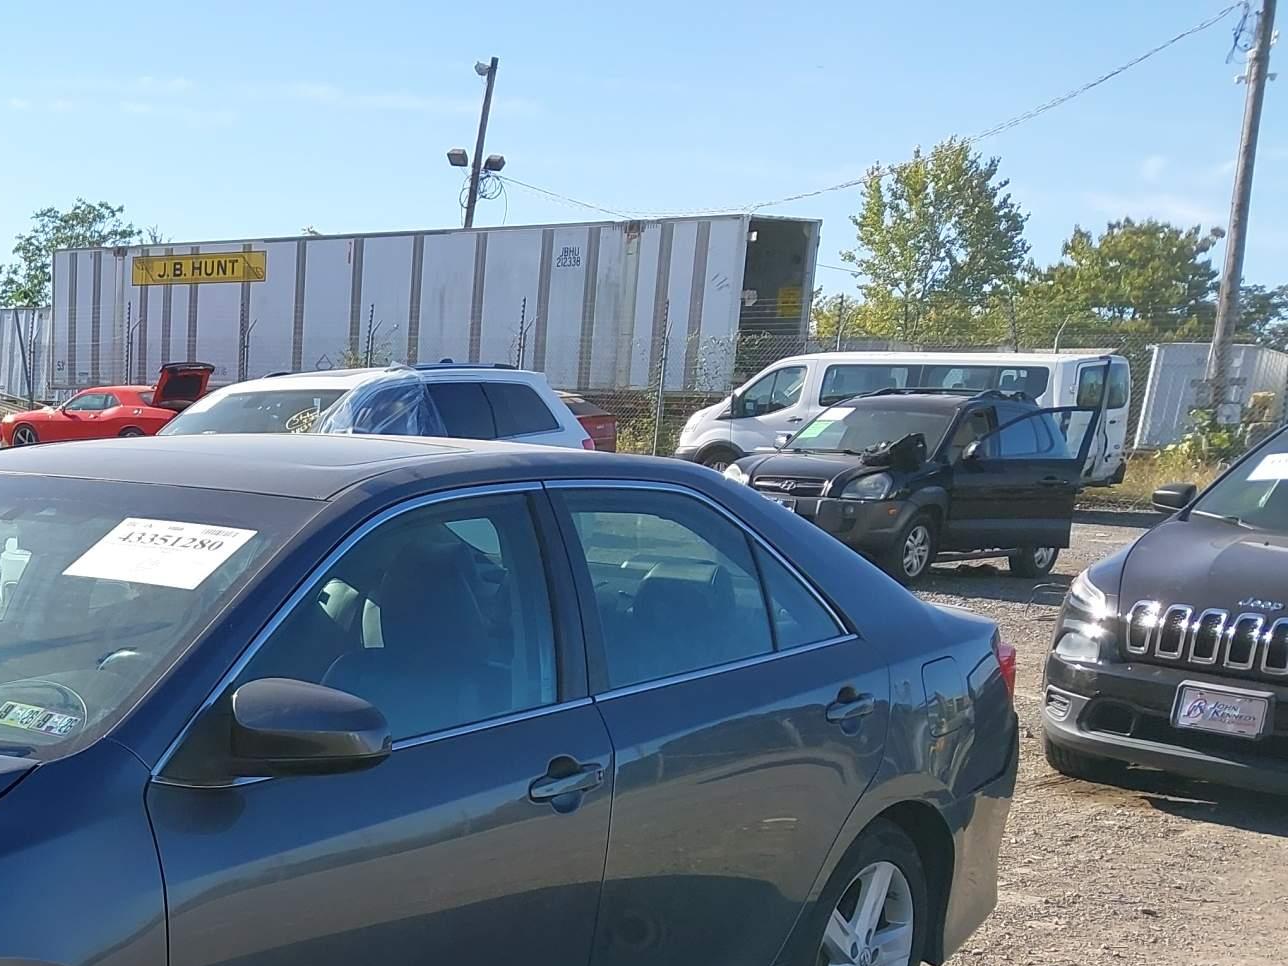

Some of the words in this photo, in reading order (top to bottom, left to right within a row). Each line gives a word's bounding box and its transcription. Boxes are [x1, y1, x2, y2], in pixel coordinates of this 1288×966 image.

[560, 247, 580, 257] JBHU
[191, 259, 238, 276] HUNT
[118, 531, 224, 551] 43351280
[1209, 701, 1239, 712] JOHN
[1210, 709, 1256, 721] KENNEDY
